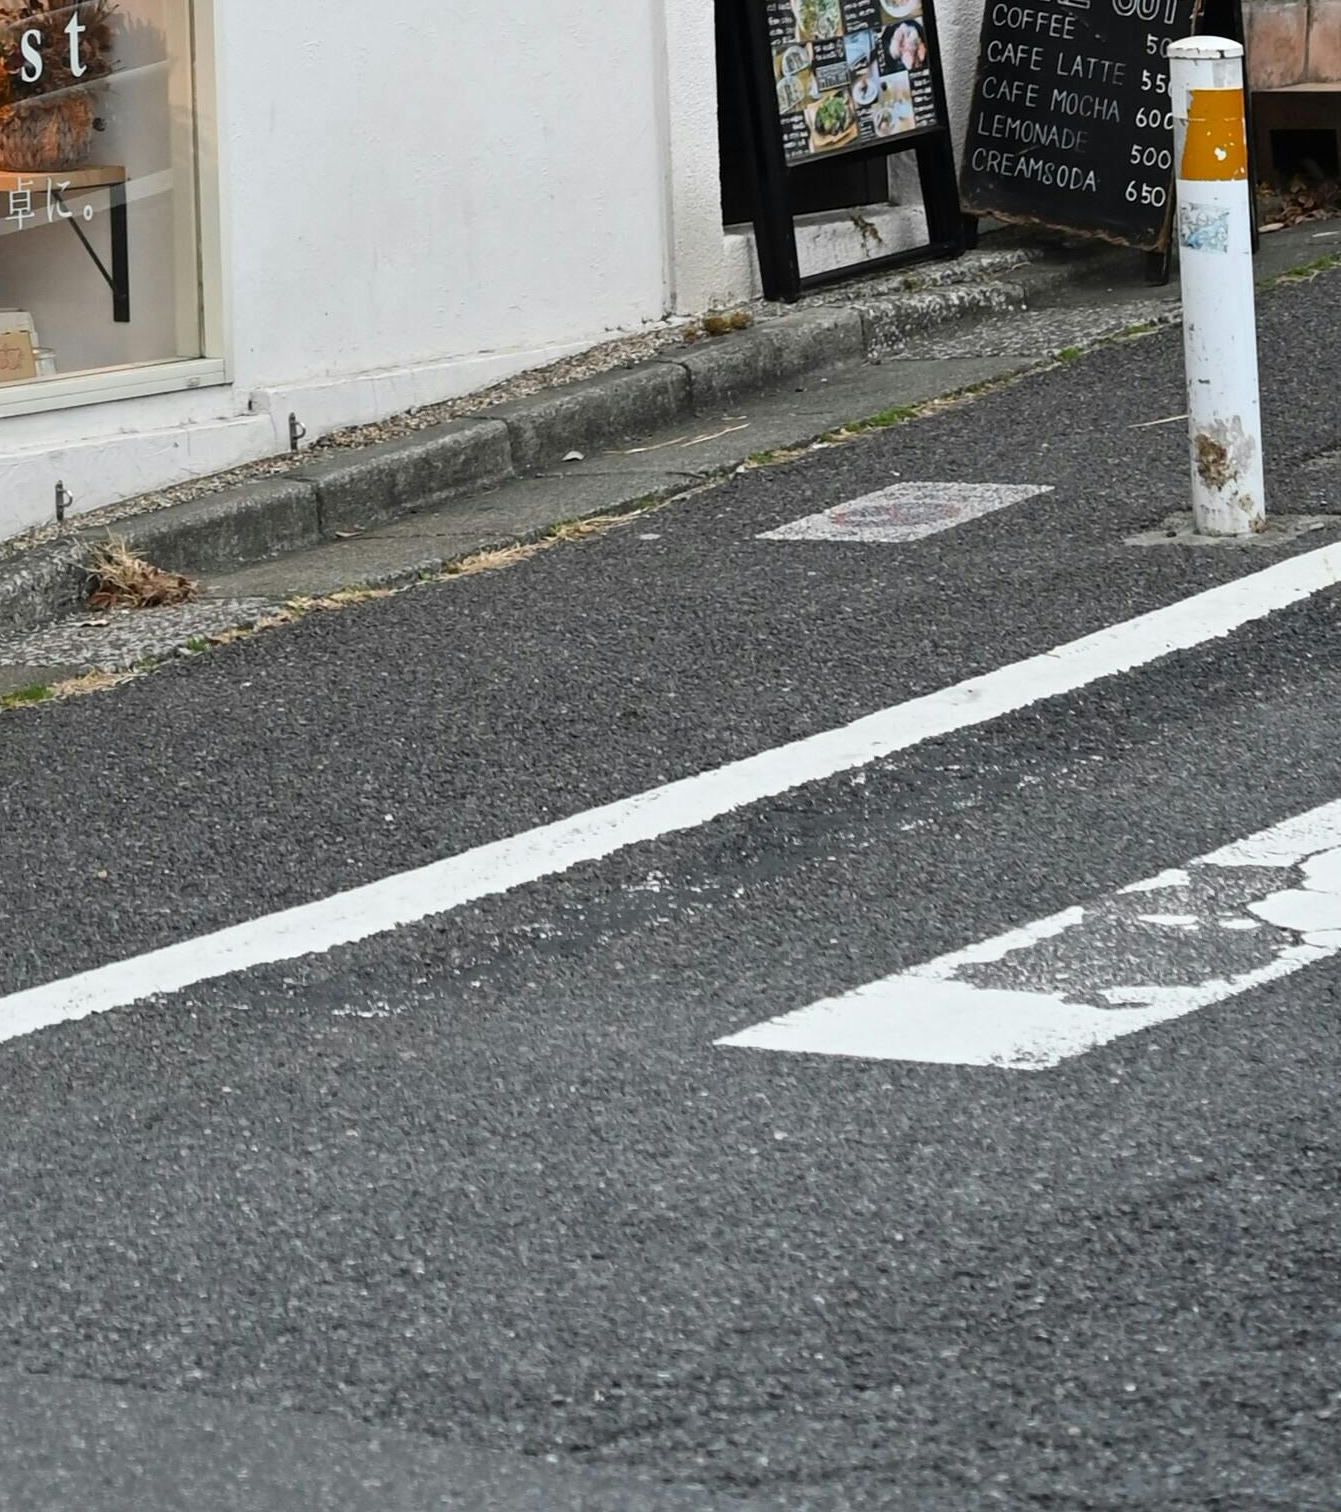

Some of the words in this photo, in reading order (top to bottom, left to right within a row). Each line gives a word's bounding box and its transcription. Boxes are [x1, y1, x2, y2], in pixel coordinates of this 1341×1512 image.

[992, 3, 1076, 41] COFFEE
[987, 39, 1044, 72] CAFE
[1057, 51, 1126, 86] LATTE
[1140, 68, 1173, 99] 55
[981, 75, 1038, 108] CAFE
[1050, 87, 1121, 124] MOCHA
[976, 111, 1088, 155] LEMONADE
[1129, 145, 1172, 170] 500
[971, 147, 1098, 193] CREAMSODA
[1124, 179, 1167, 208] 650
